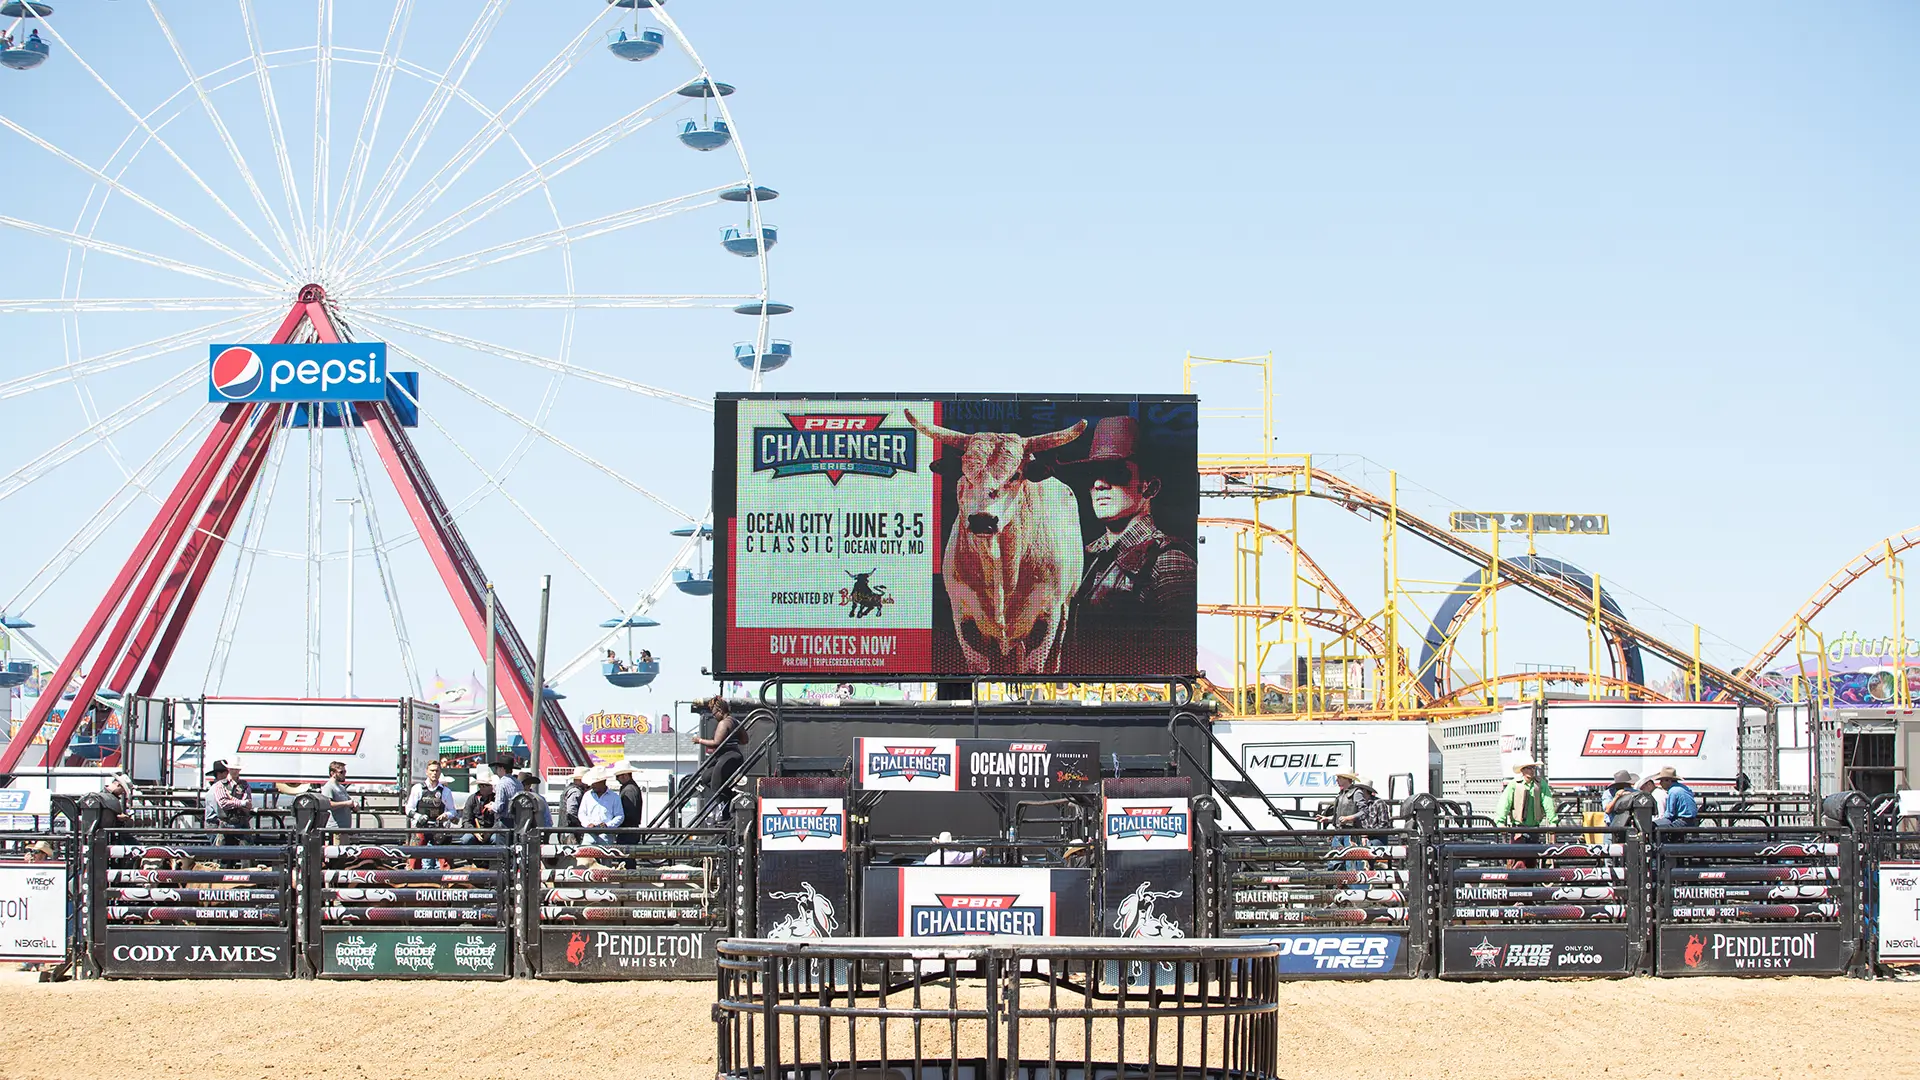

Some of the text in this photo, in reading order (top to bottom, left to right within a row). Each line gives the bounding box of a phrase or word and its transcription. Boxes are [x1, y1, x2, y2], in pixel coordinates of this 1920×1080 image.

[270, 352, 377, 393] pepsi
[804, 418, 866, 430] PBR
[761, 433, 907, 466] CHALLENGER
[811, 463, 855, 471] SERIES
[746, 513, 833, 534] OCEAN CITY
[844, 513, 924, 539] JUNE 3-5
[746, 535, 833, 553] CLASSIC
[844, 540, 924, 556] OCEAN CITY, MD
[771, 592, 820, 605] PRESENTED
[823, 592, 835, 605] BY
[770, 635, 897, 654] BUY TICKETS NOW!
[782, 657, 809, 667] PBR.COM
[585, 709, 650, 735] TICKETS
[246, 730, 358, 748] PBR
[584, 734, 607, 744] SELF
[1589, 733, 1700, 749] PBR
[1011, 744, 1046, 752] PBR
[872, 756, 946, 773] CHALLENGER
[970, 752, 1016, 776] OCEAN
[1024, 753, 1052, 776] CITY
[1250, 753, 1343, 768] MOBILE
[970, 777, 1051, 788] CLASSIC
[766, 816, 837, 832] CHALLENGER
[1112, 816, 1182, 832] CHALLENGER
[26, 877, 55, 886] WRECK
[1890, 877, 1918, 887] WRECK
[198, 890, 250, 901] CHALLENGER
[415, 890, 468, 901] CHALLENGER
[636, 890, 689, 901] CHALLENGER
[1235, 891, 1289, 903] CHALLENGER
[1455, 888, 1508, 900] CHALLENGER
[1673, 888, 1725, 899] CHALLENGER
[951, 898, 1003, 907] PBR
[195, 909, 214, 918] OCEAN
[243, 909, 259, 918] 2022
[414, 909, 433, 919] OCEAN
[461, 910, 477, 919] 2022
[632, 909, 652, 918] OCEAN
[681, 909, 697, 918] 2022
[1235, 911, 1254, 920] OCEAN
[1284, 912, 1300, 921] 2022
[1456, 909, 1475, 918] OCEAN
[1504, 909, 1520, 918] 2022
[1673, 908, 1692, 917] OCEAN
[1720, 908, 1735, 917] 2022
[917, 910, 1035, 937] CHALLENGER
[348, 936, 365, 945] U.S.
[407, 936, 424, 945] U.S.
[467, 936, 484, 945] U.S.
[595, 932, 704, 959] PENDLETON
[1712, 932, 1816, 960] PENDLETON
[336, 946, 376, 957] BORDER
[395, 946, 435, 957] BORDER
[455, 946, 495, 957] BORDER
[1269, 937, 1389, 956] OOPER
[1507, 944, 1554, 956] RIDE
[113, 945, 278, 963] CODY JAMES
[337, 957, 375, 967] PATROL
[396, 957, 434, 967] PATROL
[456, 957, 494, 967] PATROL
[619, 958, 678, 968] WHISKY
[1313, 955, 1386, 969] TIRES
[1504, 956, 1551, 967] PASS
[1735, 958, 1792, 968] WHISKY
